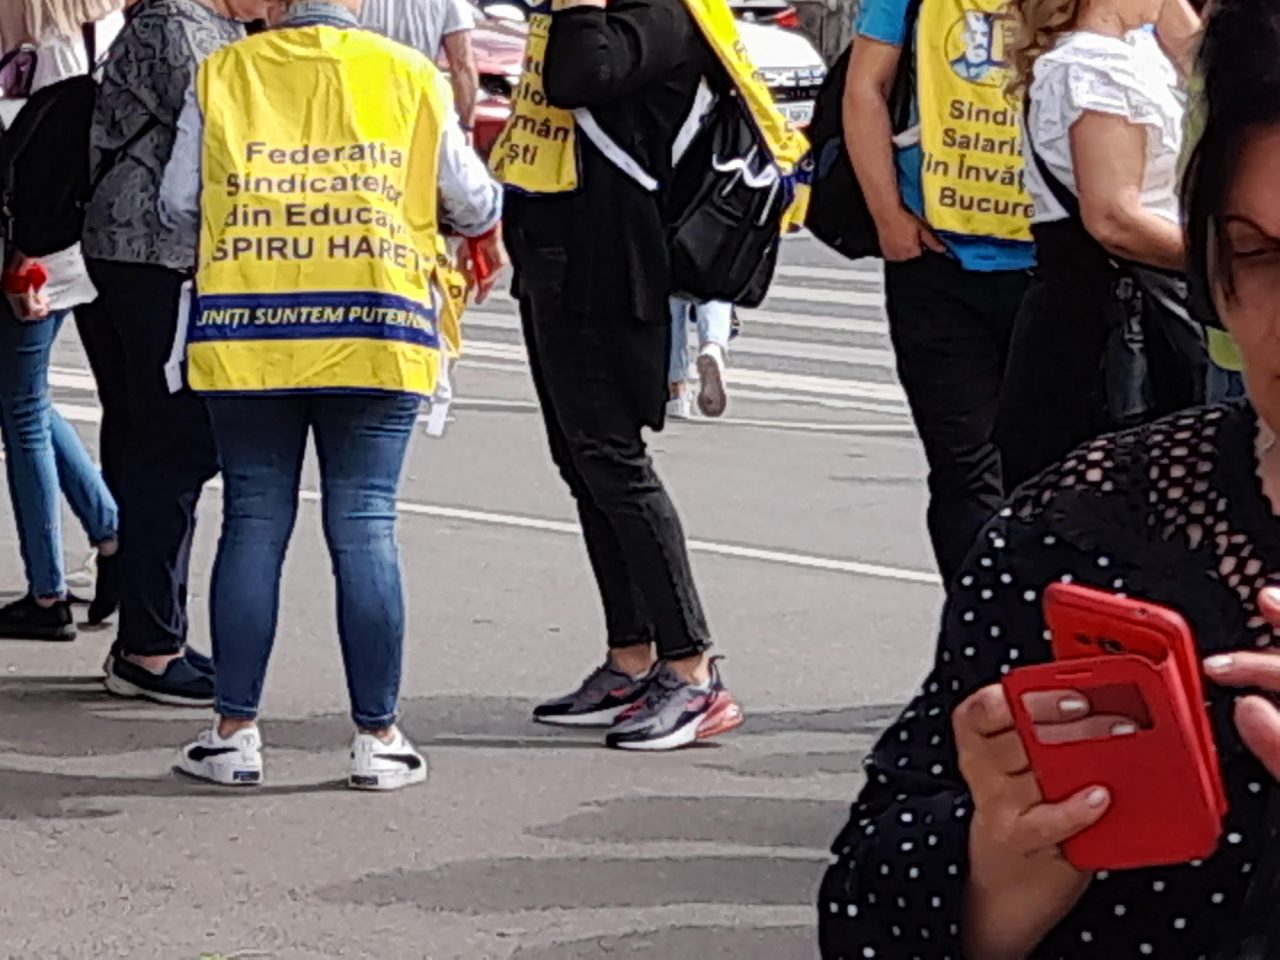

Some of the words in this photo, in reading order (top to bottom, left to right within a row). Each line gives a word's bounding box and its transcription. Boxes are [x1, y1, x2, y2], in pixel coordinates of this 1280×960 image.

[246, 141, 402, 168] Federația
[224, 204, 271, 227] din
[254, 305, 345, 325] SUNTEM
